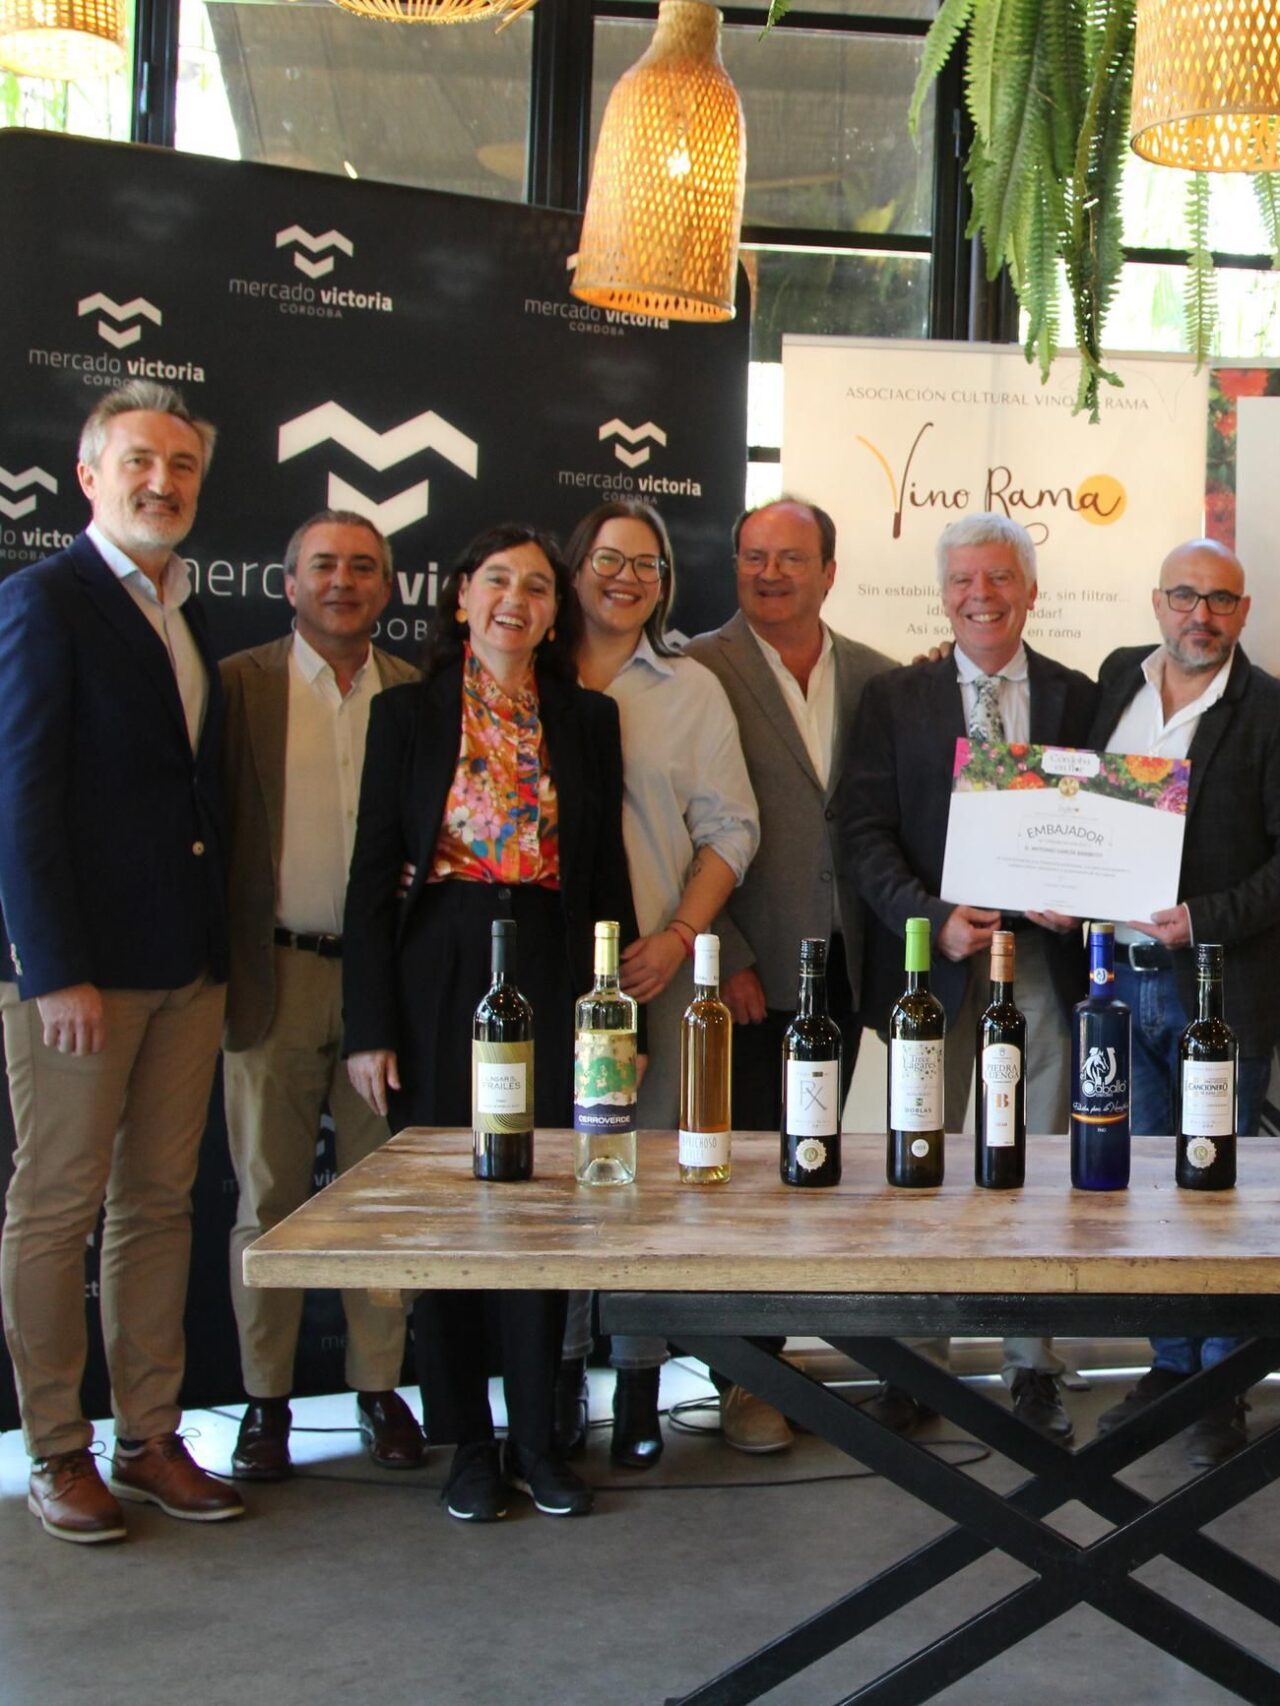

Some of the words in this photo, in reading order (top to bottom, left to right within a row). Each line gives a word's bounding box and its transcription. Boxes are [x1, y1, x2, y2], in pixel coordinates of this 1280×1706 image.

[229, 277, 315, 302] mercado
[320, 286, 393, 312] victoria
[525, 299, 600, 321] mercado
[29, 348, 121, 374] mercado
[127, 357, 205, 383] victoria
[846, 386, 946, 402] ASOCIACIÓN
[951, 391, 1028, 407] CULTURAL
[1034, 393, 1074, 406] VINO
[1105, 398, 1149, 410] RAMA
[559, 471, 633, 490] mercado
[638, 475, 702, 496] victoria
[856, 422, 970, 539] Vino
[985, 466, 1122, 518] Rama
[858, 584, 880, 597] Sin
[1057, 589, 1076, 600] sin
[1027, 629, 1043, 637] en
[1049, 629, 1081, 638] rama
[1027, 824, 1104, 846] EMBAJADOR
[985, 1072, 1020, 1080] LUENGA
[986, 1064, 1018, 1072] PIEDRA
[1188, 1083, 1228, 1091] CANCIONERO
[578, 1114, 631, 1124] CERROVERDE
